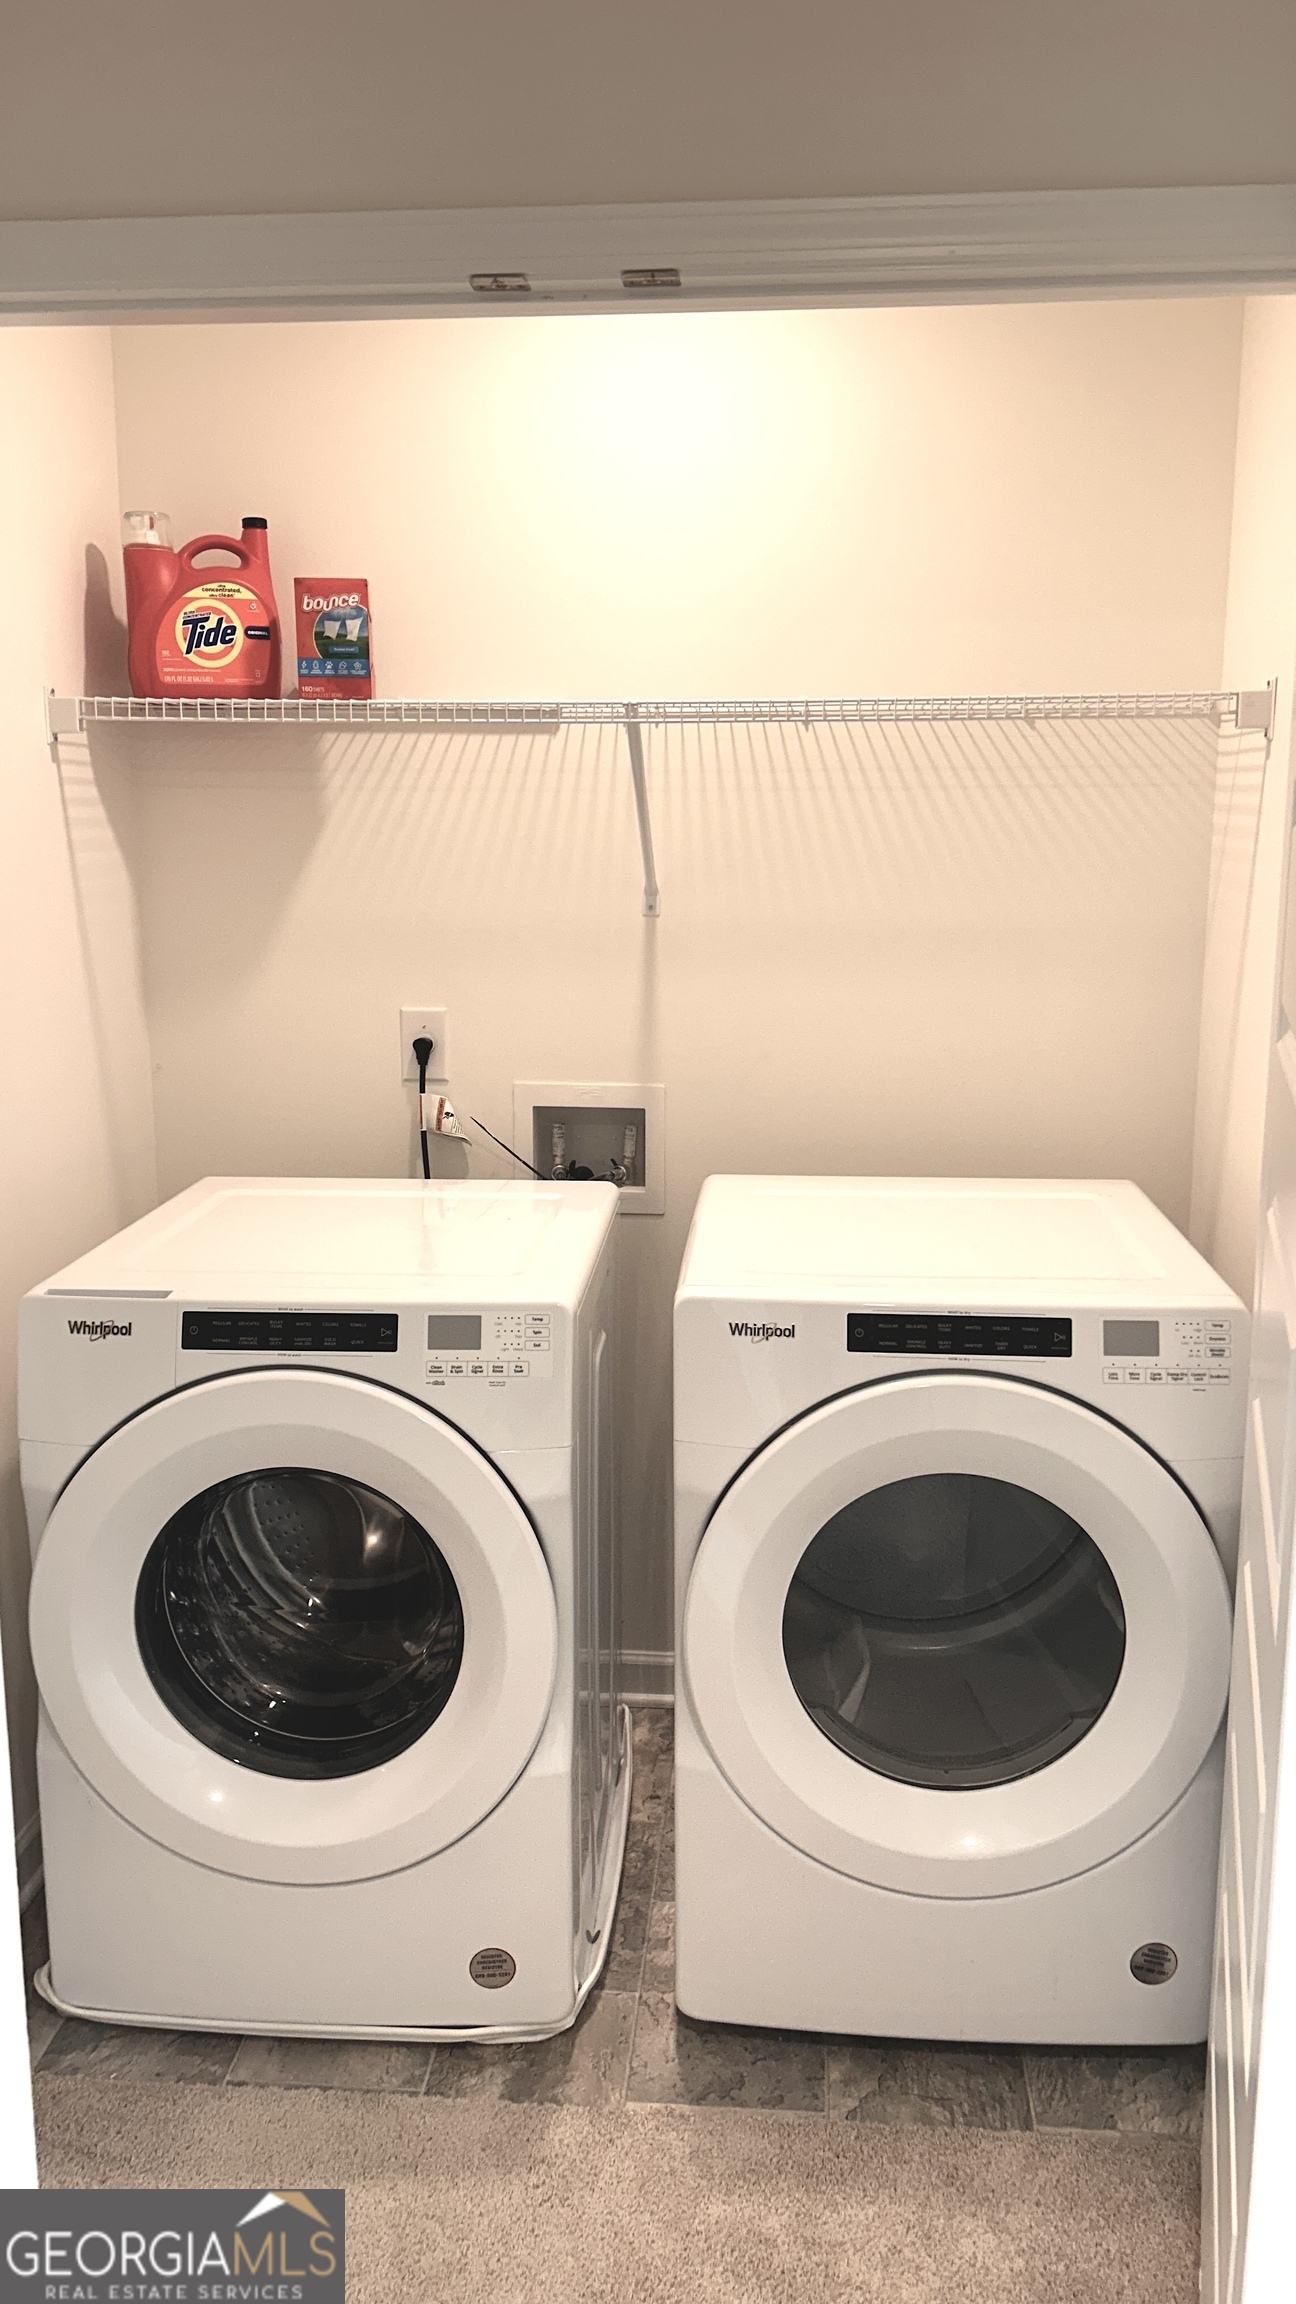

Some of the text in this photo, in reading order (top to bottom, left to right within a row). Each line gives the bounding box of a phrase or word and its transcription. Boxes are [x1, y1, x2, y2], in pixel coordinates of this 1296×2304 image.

[302, 593, 360, 612] bounce
[181, 616, 237, 655] Tide
[68, 1320, 132, 1340] Whirlpool
[728, 1322, 796, 1341] Whirlpool
